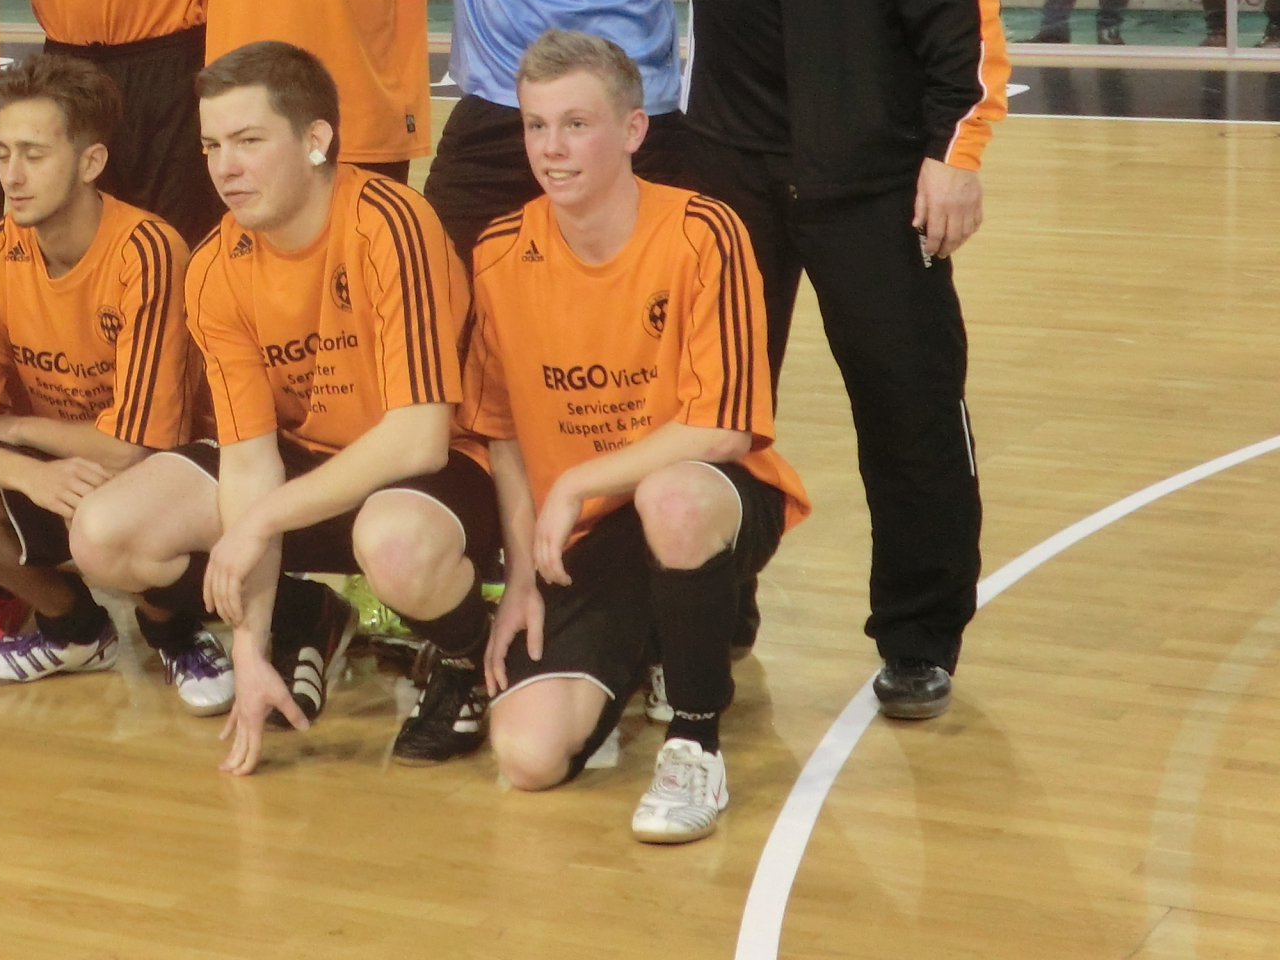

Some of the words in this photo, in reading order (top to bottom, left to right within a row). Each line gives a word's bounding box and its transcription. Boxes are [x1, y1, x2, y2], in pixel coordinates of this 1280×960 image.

[12, 344, 70, 374] ERGO
[35, 376, 113, 398] Servicecente
[542, 364, 609, 391] ERGO
[558, 421, 613, 437] Küspert
[617, 418, 627, 431] &
